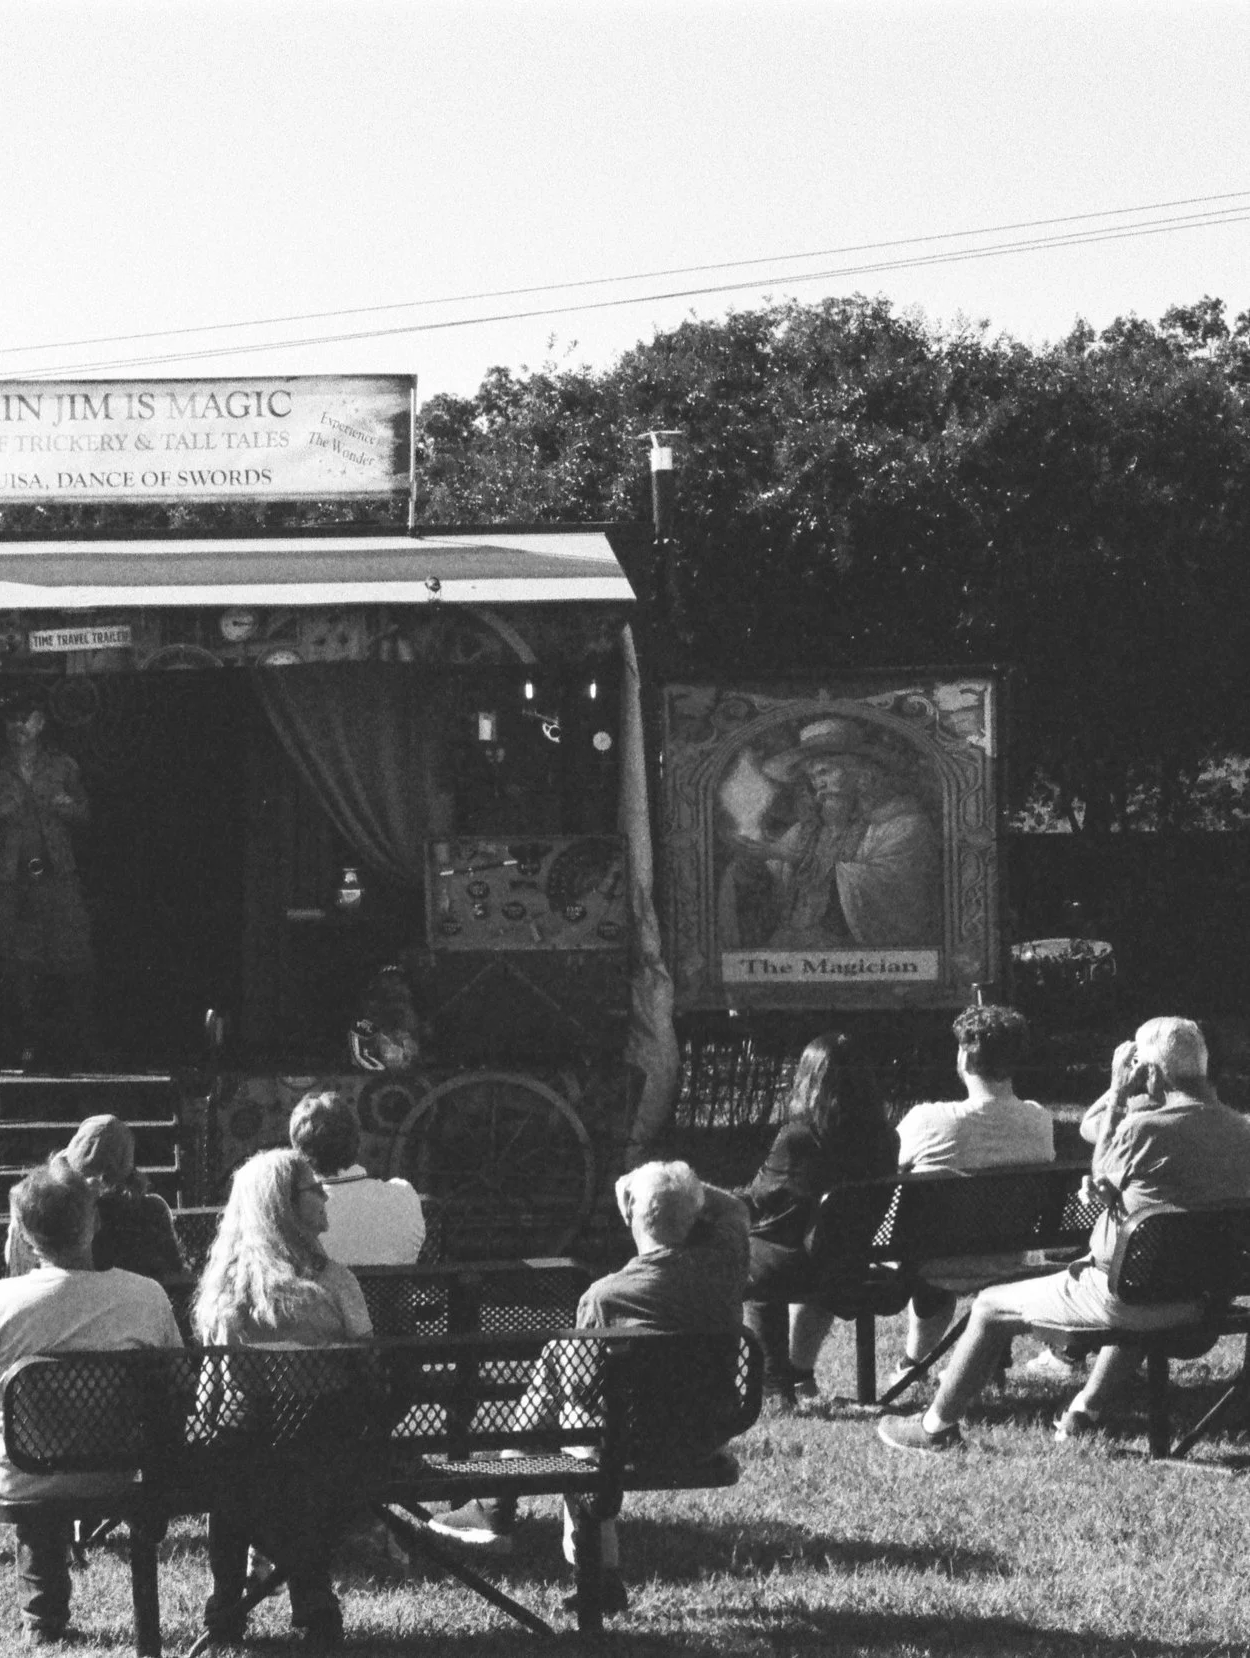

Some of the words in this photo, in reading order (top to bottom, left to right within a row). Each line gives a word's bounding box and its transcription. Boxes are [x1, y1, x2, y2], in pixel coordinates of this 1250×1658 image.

[52, 393, 114, 427] JIM
[125, 392, 157, 421] IS
[167, 389, 293, 420] MAGIC
[320, 411, 377, 445] Experience
[15, 433, 129, 453] TRICKERY
[133, 432, 154, 451] &
[159, 432, 218, 451] TALL
[222, 430, 291, 450] TALES
[309, 431, 330, 448] The
[332, 438, 376, 466] Wonder
[57, 471, 136, 489] DANCE
[141, 470, 172, 487] OF
[177, 468, 272, 486] SWORDS
[33, 634, 54, 648] TIME
[57, 632, 90, 646] TRAVEL
[738, 958, 793, 975] The
[802, 957, 919, 976] Magician
